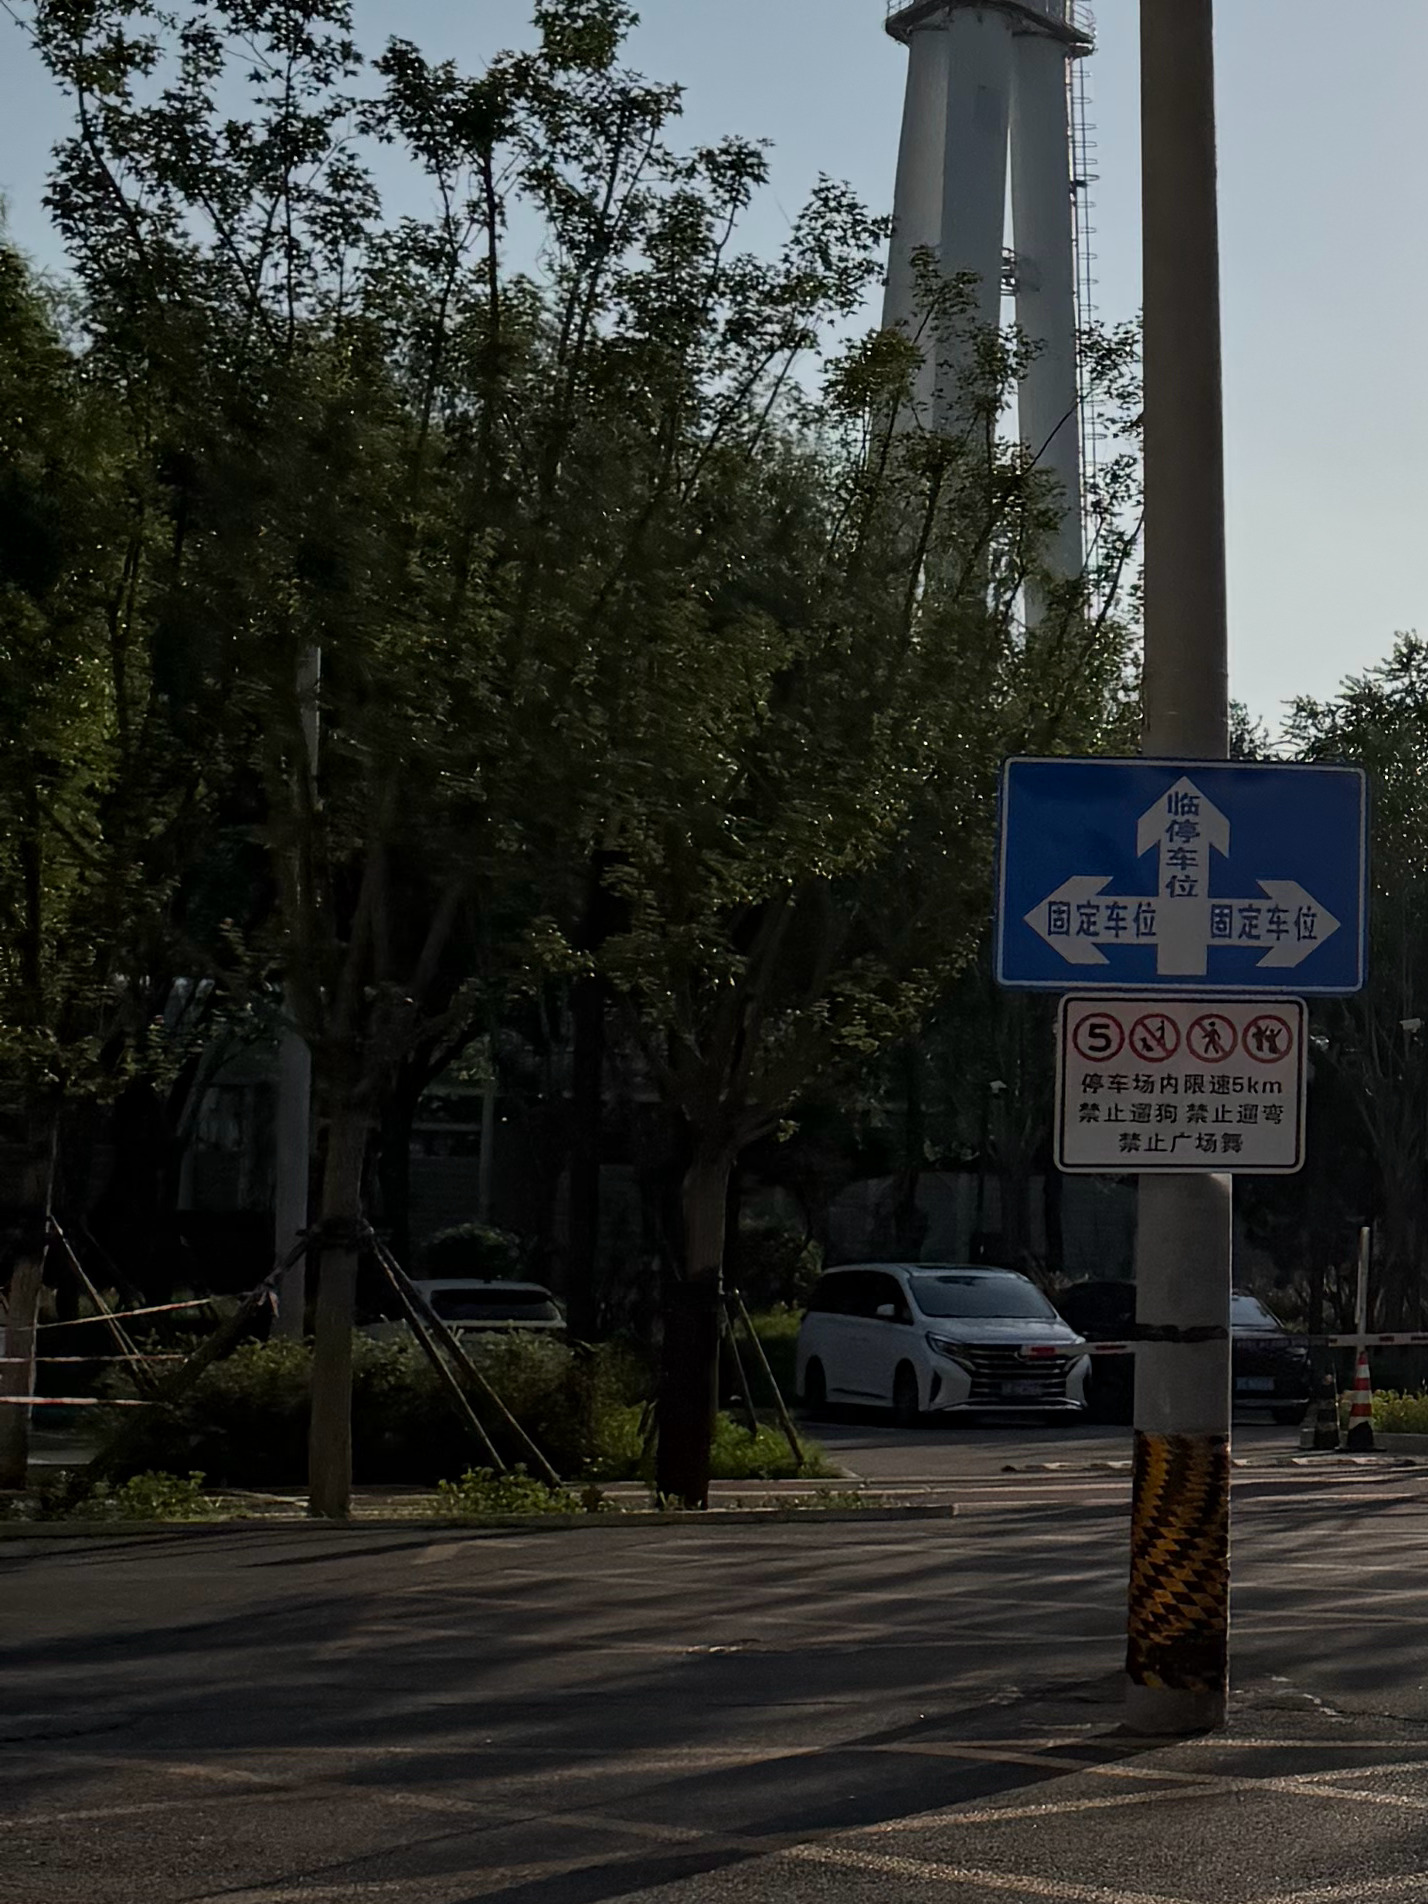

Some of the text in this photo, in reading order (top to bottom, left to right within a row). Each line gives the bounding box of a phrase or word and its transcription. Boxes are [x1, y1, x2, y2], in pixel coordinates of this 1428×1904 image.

[1165, 790, 1200, 898] 临停车位
[1047, 900, 1157, 939] 固定车位
[1210, 903, 1318, 942] 固定车位
[1088, 1023, 1112, 1053] 5
[1081, 1073, 1283, 1095] 停车场内限速5km
[1078, 1103, 1285, 1125] 禁止遛狗 禁止遛弯
[1118, 1132, 1244, 1154] 禁止广场舞
